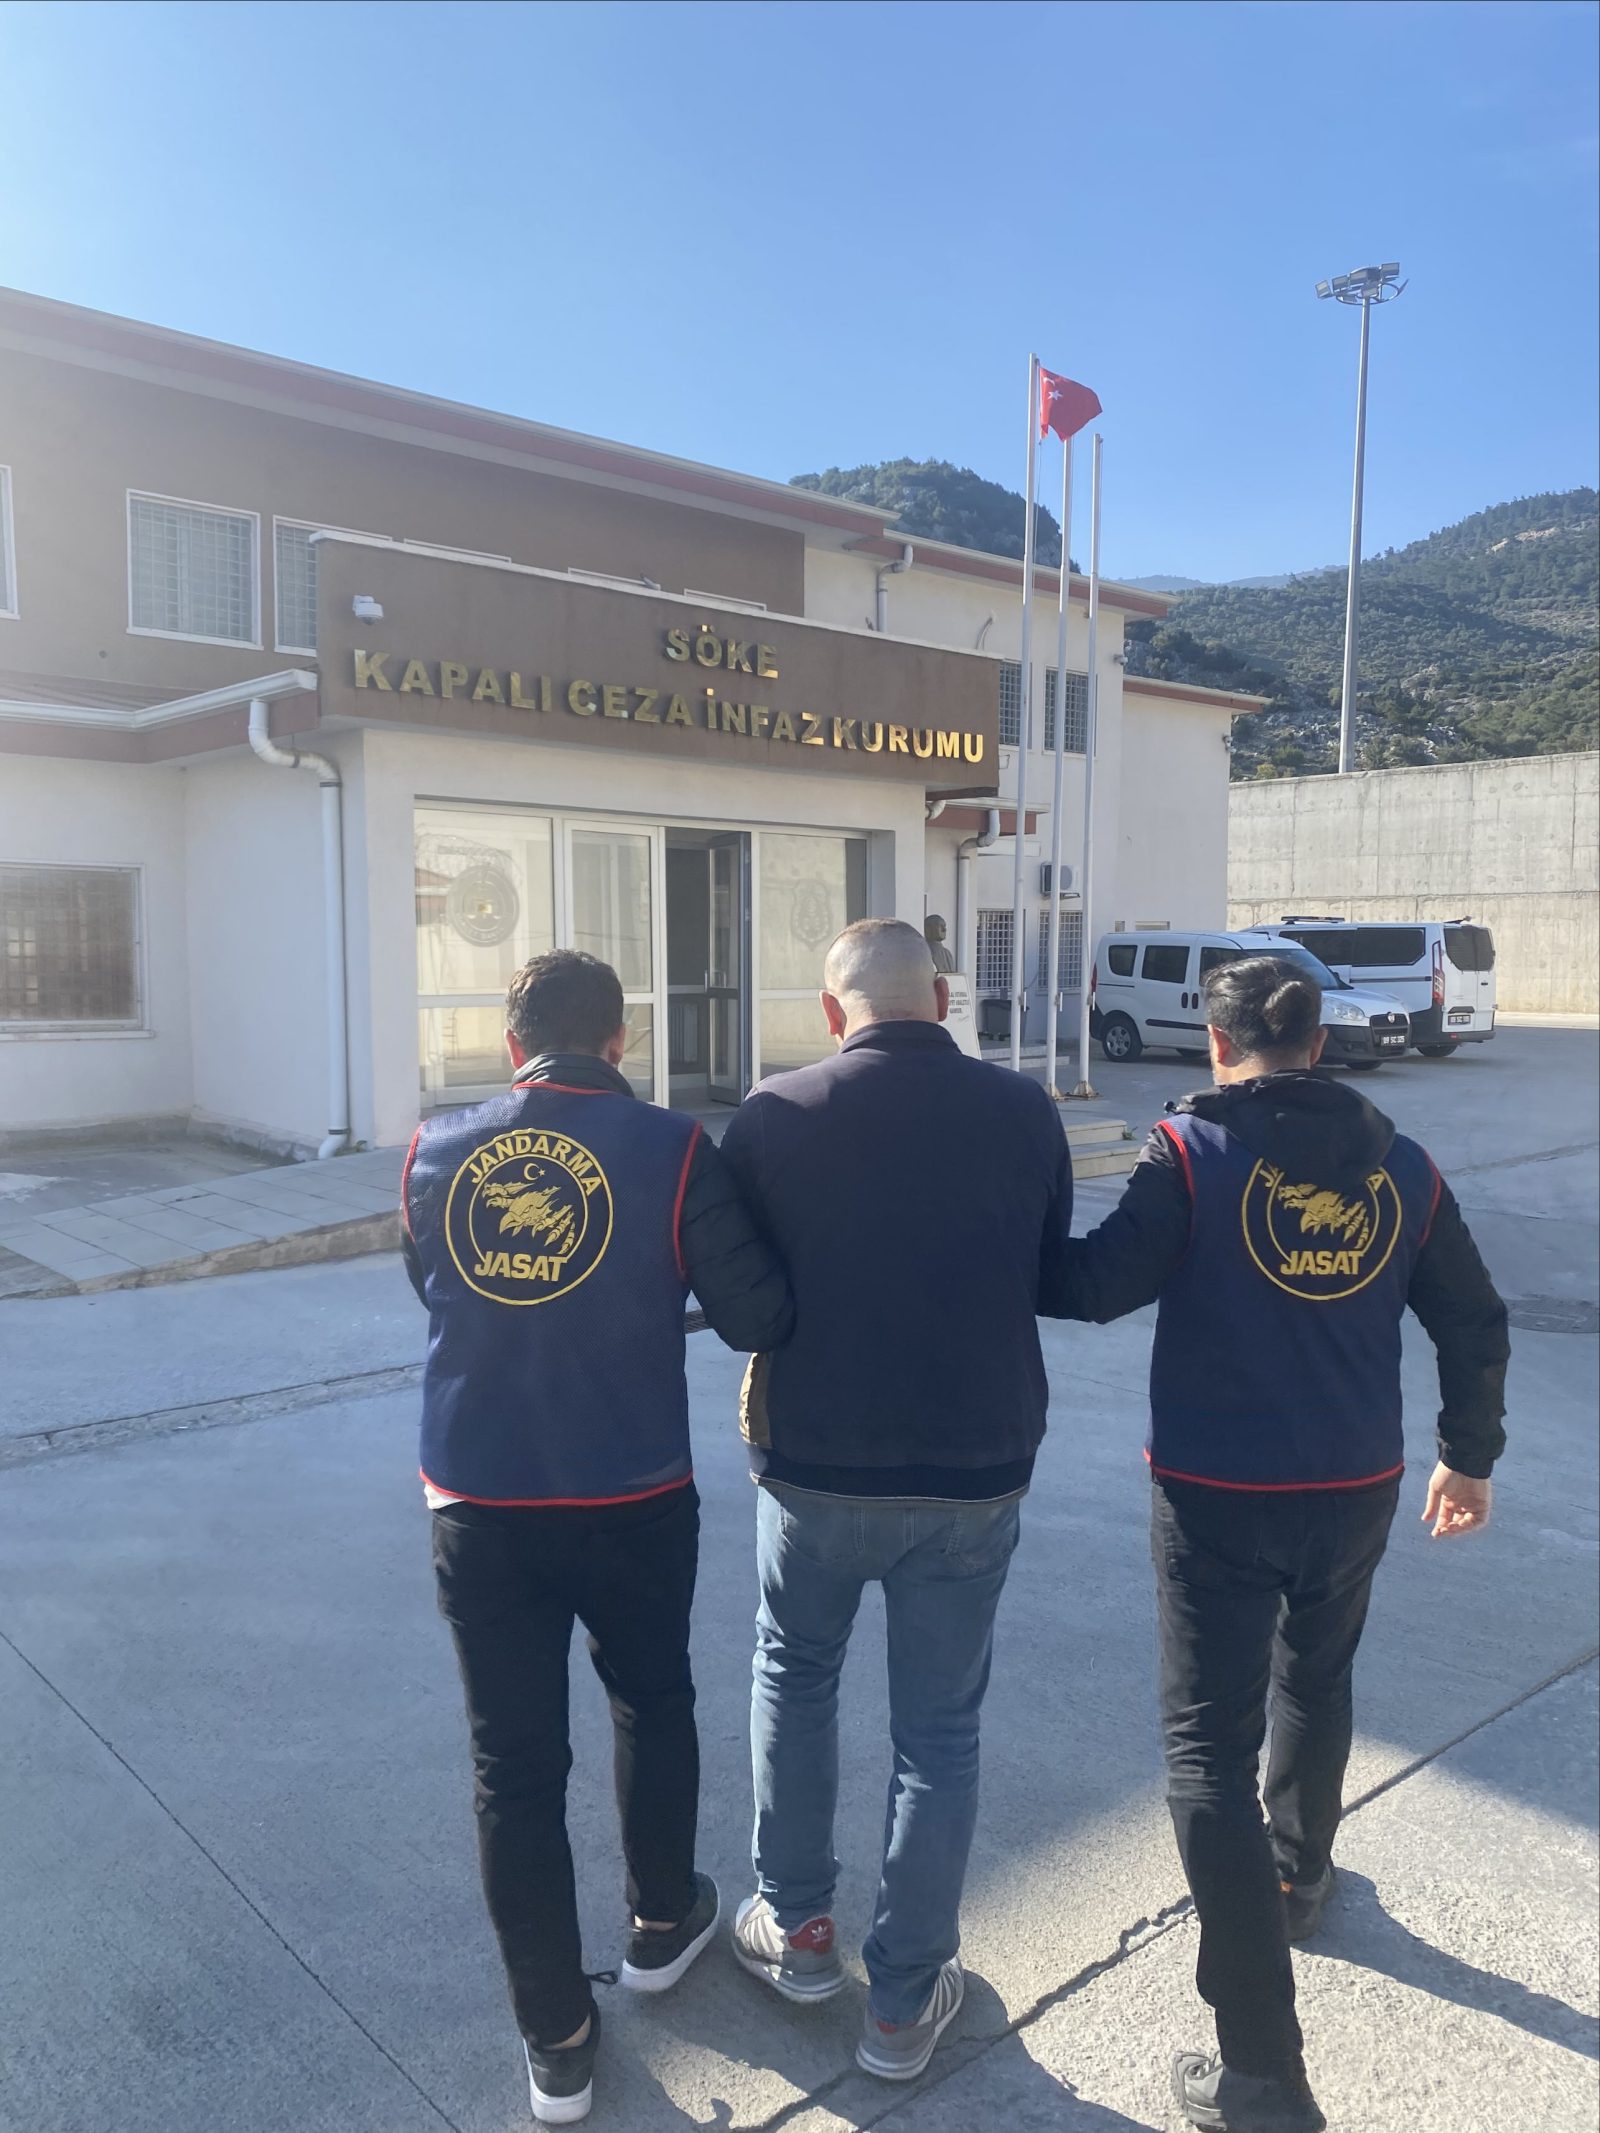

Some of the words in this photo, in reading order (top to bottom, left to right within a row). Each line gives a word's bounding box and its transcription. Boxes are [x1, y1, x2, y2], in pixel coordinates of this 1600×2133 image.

[665, 624, 779, 680] SÖKE
[354, 649, 552, 712] KAPALI
[568, 679, 694, 726] CEZA
[706, 688, 824, 745] İNFAZ
[833, 716, 984, 763] KURUMU
[467, 1135, 602, 1196] JANDARMA
[474, 1250, 568, 1282] JASAT
[1280, 1250, 1364, 1275] JASAT
